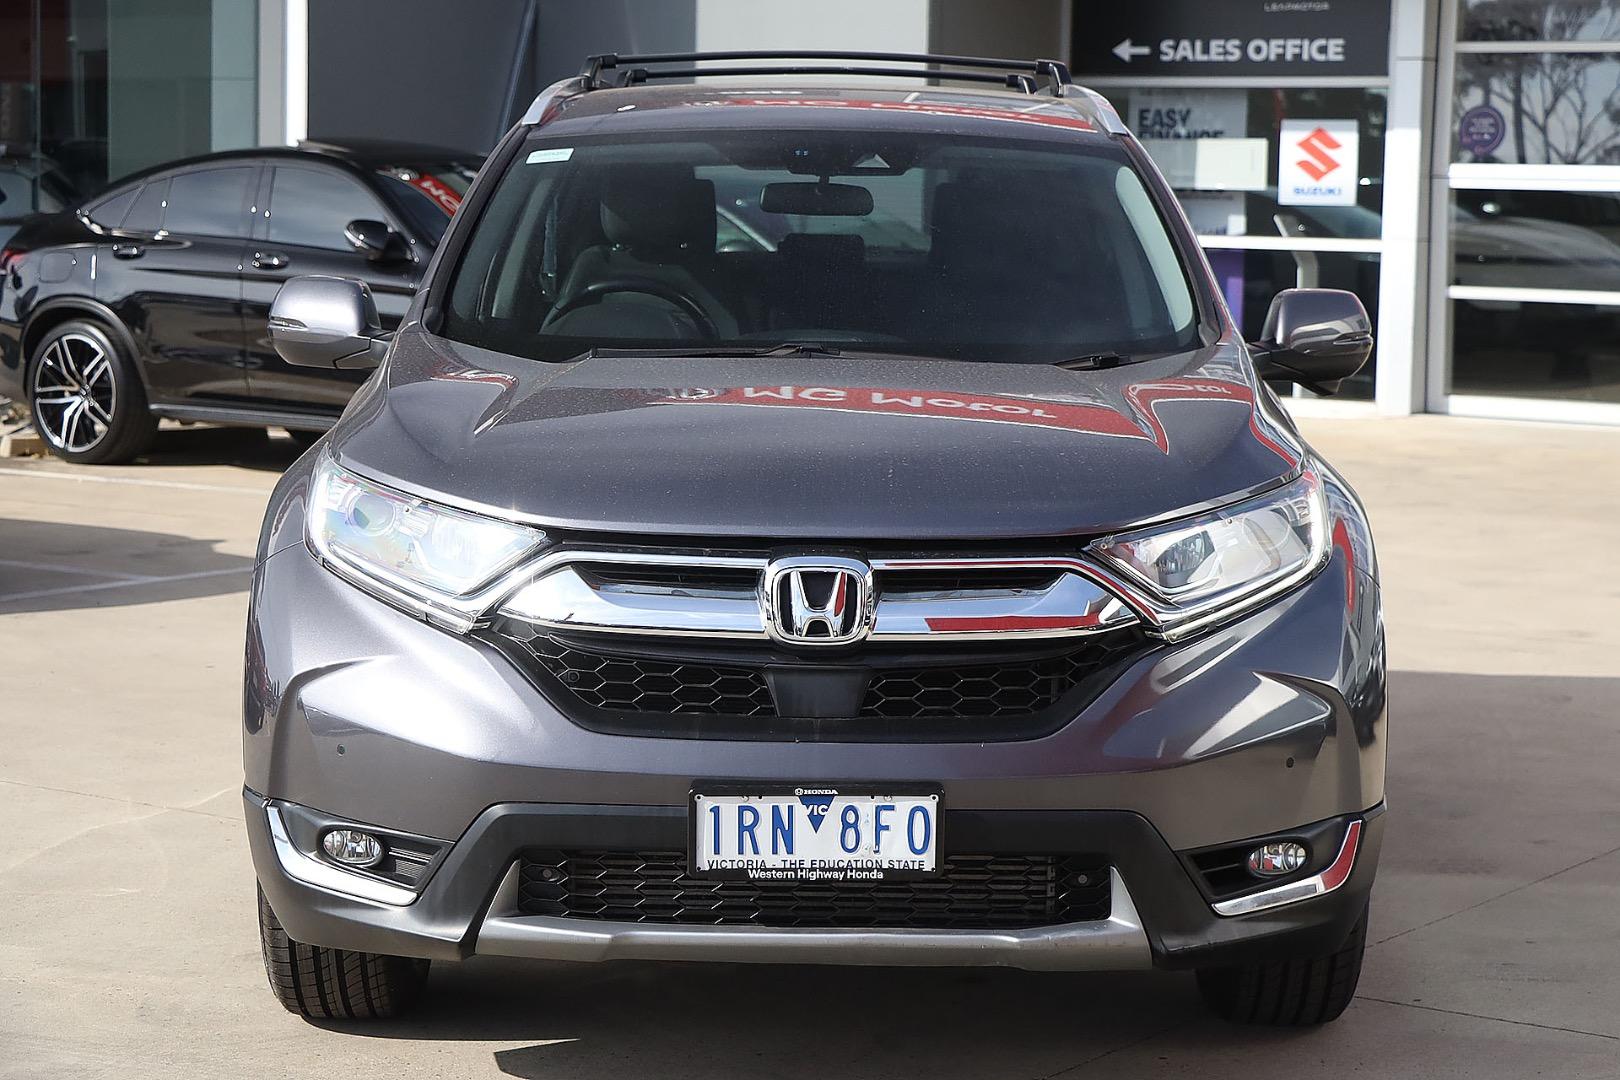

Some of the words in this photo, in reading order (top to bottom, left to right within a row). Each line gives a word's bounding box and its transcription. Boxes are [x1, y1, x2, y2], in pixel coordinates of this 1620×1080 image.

[1159, 38, 1242, 62] SALES
[1246, 38, 1345, 62] OFFICE
[1138, 108, 1191, 129] EASY
[804, 804, 829, 816] VIC
[709, 805, 795, 855] 1RN
[707, 859, 767, 869] VICTORIA
[780, 859, 805, 869] THE
[810, 859, 882, 869] EDUCATION
[887, 860, 925, 869] STATE
[747, 868, 795, 879] Western
[797, 868, 844, 880] Highway
[846, 868, 884, 879] Honda
